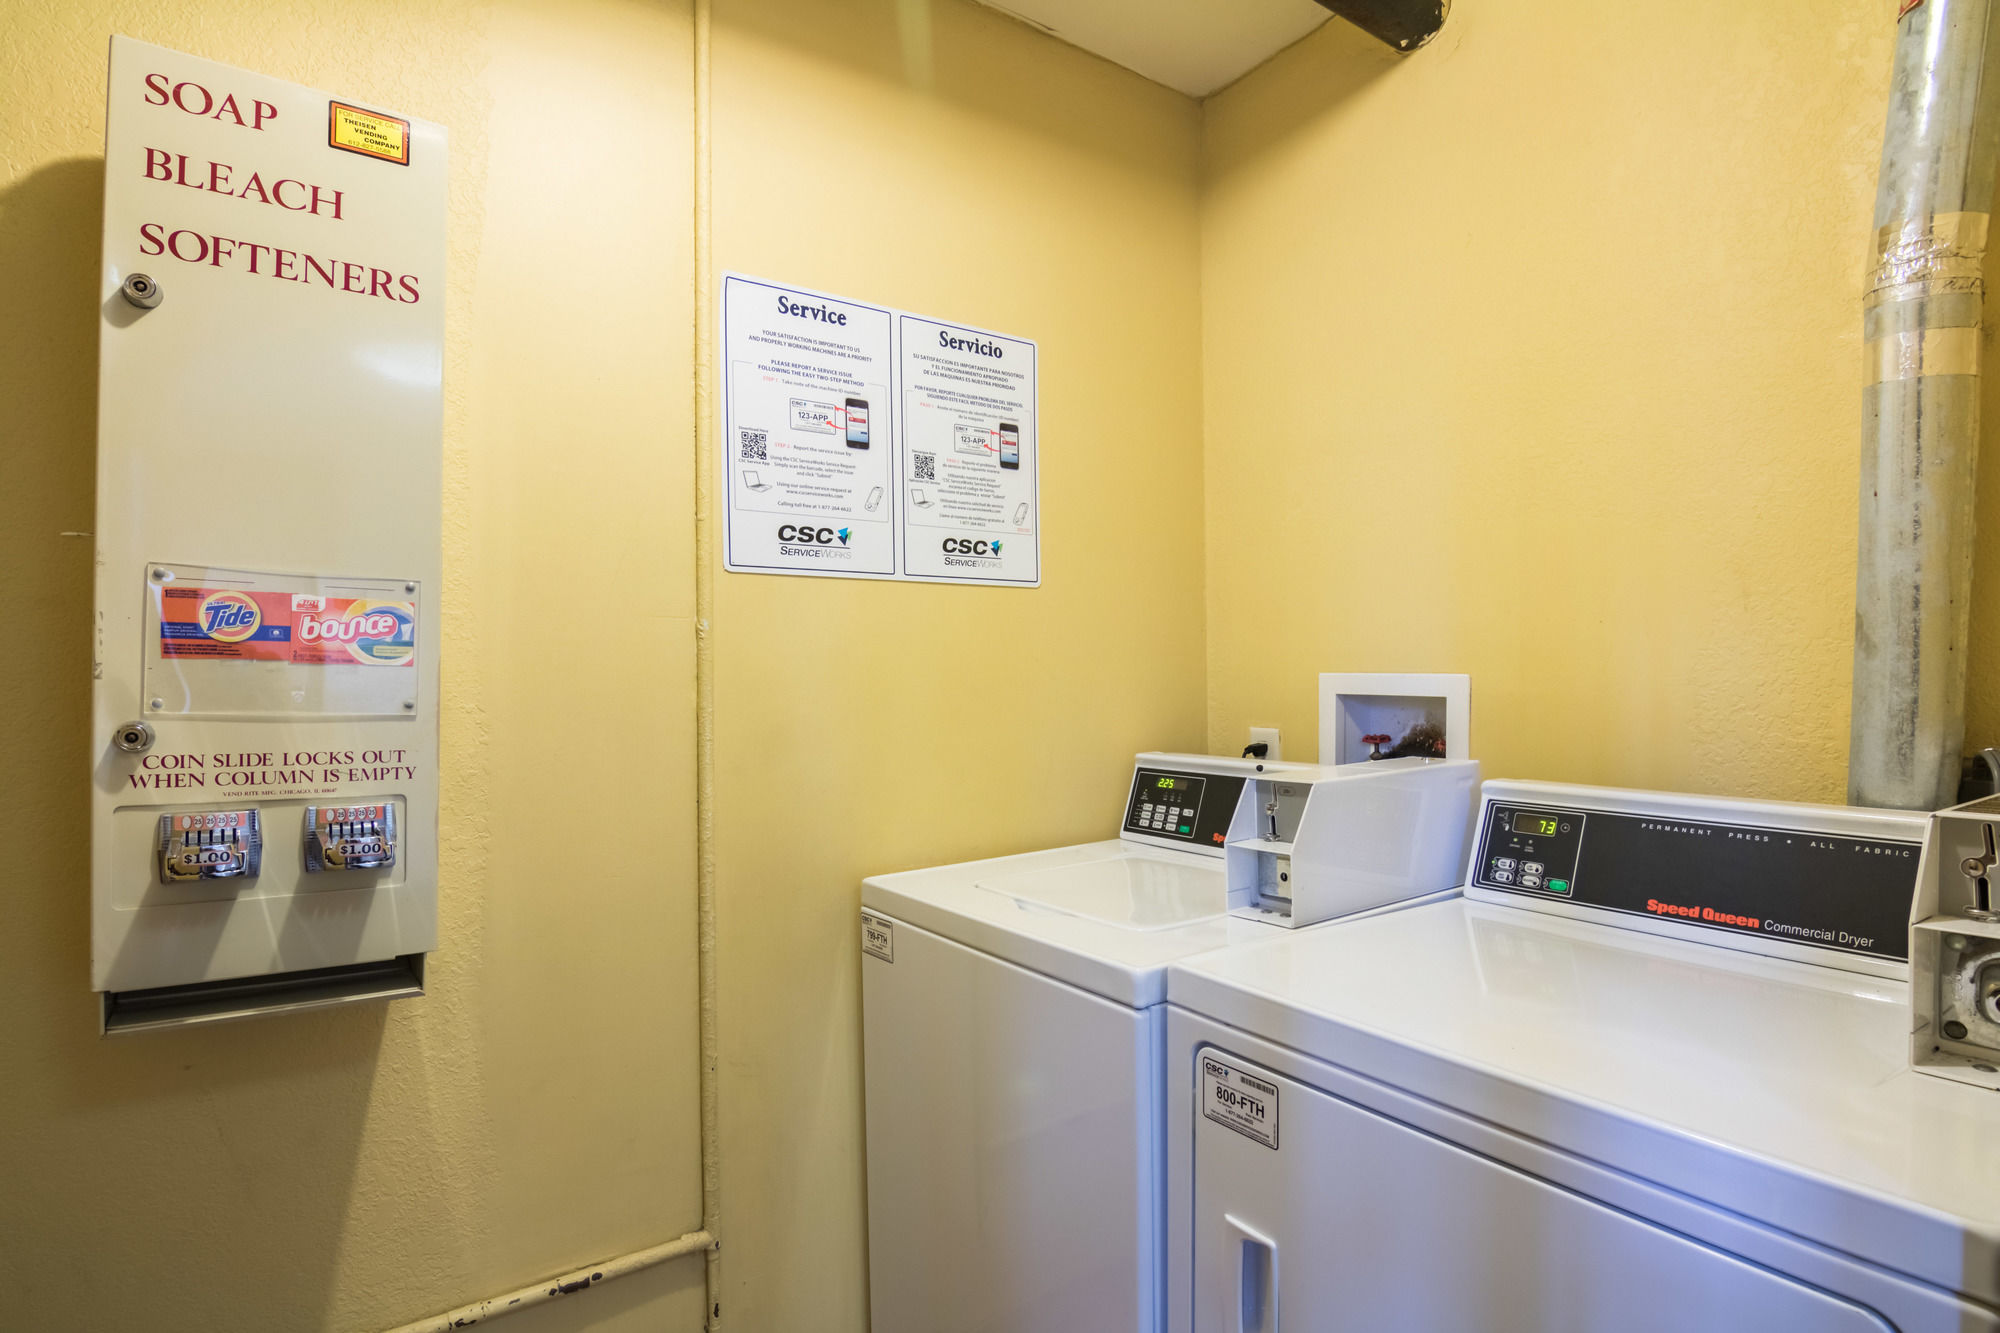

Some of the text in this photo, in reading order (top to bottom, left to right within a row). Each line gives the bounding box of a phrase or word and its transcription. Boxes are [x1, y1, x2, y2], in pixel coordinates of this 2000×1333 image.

[145, 74, 277, 131] SOAP
[344, 118, 376, 130] THEISEN
[354, 128, 387, 140] VENDING
[364, 138, 400, 151] COMPANY
[144, 147, 344, 220] BLEACH
[140, 223, 419, 304] SOFTENERS
[778, 296, 847, 326] Service
[761, 337, 786, 346] PROPERLY
[788, 342, 811, 351] WORKING
[812, 347, 836, 356] MACHINES
[778, 333, 812, 344] SATISFACTION
[819, 340, 846, 350] IMPORTANT
[940, 330, 1002, 358] Servicio
[758, 364, 790, 374] FOLLOWING
[817, 367, 837, 375] SERVICE
[960, 362, 988, 372] IMPORTANTE
[798, 412, 828, 421] 123-APP
[778, 525, 834, 544] CSC
[942, 538, 988, 555] CSC
[204, 604, 257, 634] Tide
[300, 616, 393, 640] bounce
[142, 750, 406, 770] COIN SLIDE LOCKS OUT
[128, 766, 416, 789] WHEN COLUMN IS EMPTY
[207, 816, 215, 824] 25
[218, 815, 226, 823] 25
[230, 815, 237, 823] 25
[348, 810, 355, 818] 25
[1540, 821, 1556, 834] 73
[340, 843, 381, 855] $1.00
[1642, 823, 1911, 858] PERMANENT PRESS ALL FABRIC
[184, 851, 230, 864] $1.00
[1647, 899, 1874, 948] Speed Queen Commercial Dryer
[1205, 1062, 1223, 1074] CSC
[1216, 1086, 1264, 1118] 800-FTH
